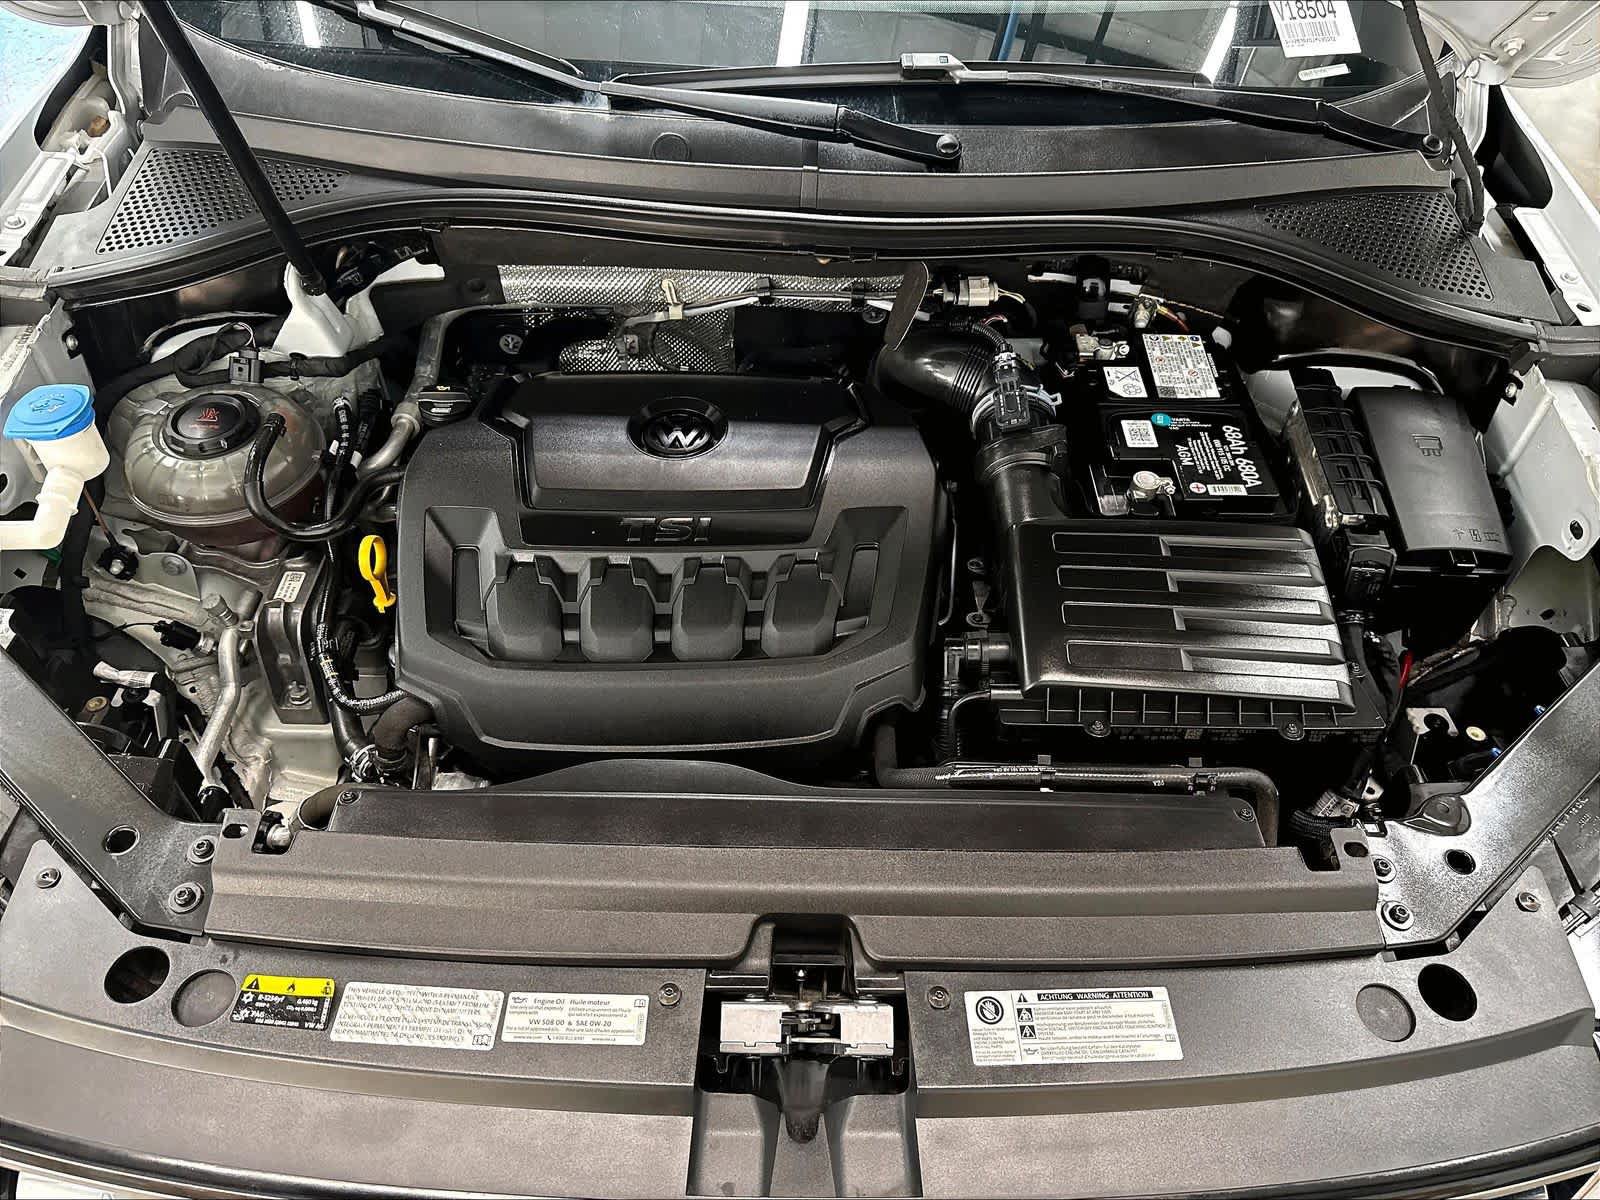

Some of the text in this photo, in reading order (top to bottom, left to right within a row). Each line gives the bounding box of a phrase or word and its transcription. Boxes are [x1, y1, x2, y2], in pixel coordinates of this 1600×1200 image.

[1273, 0, 1336, 21] V18504
[1175, 444, 1194, 466] AGM
[1222, 425, 1263, 488] 68Ah 680A
[619, 517, 711, 542] TSI
[258, 994, 285, 1002] R-1234yf
